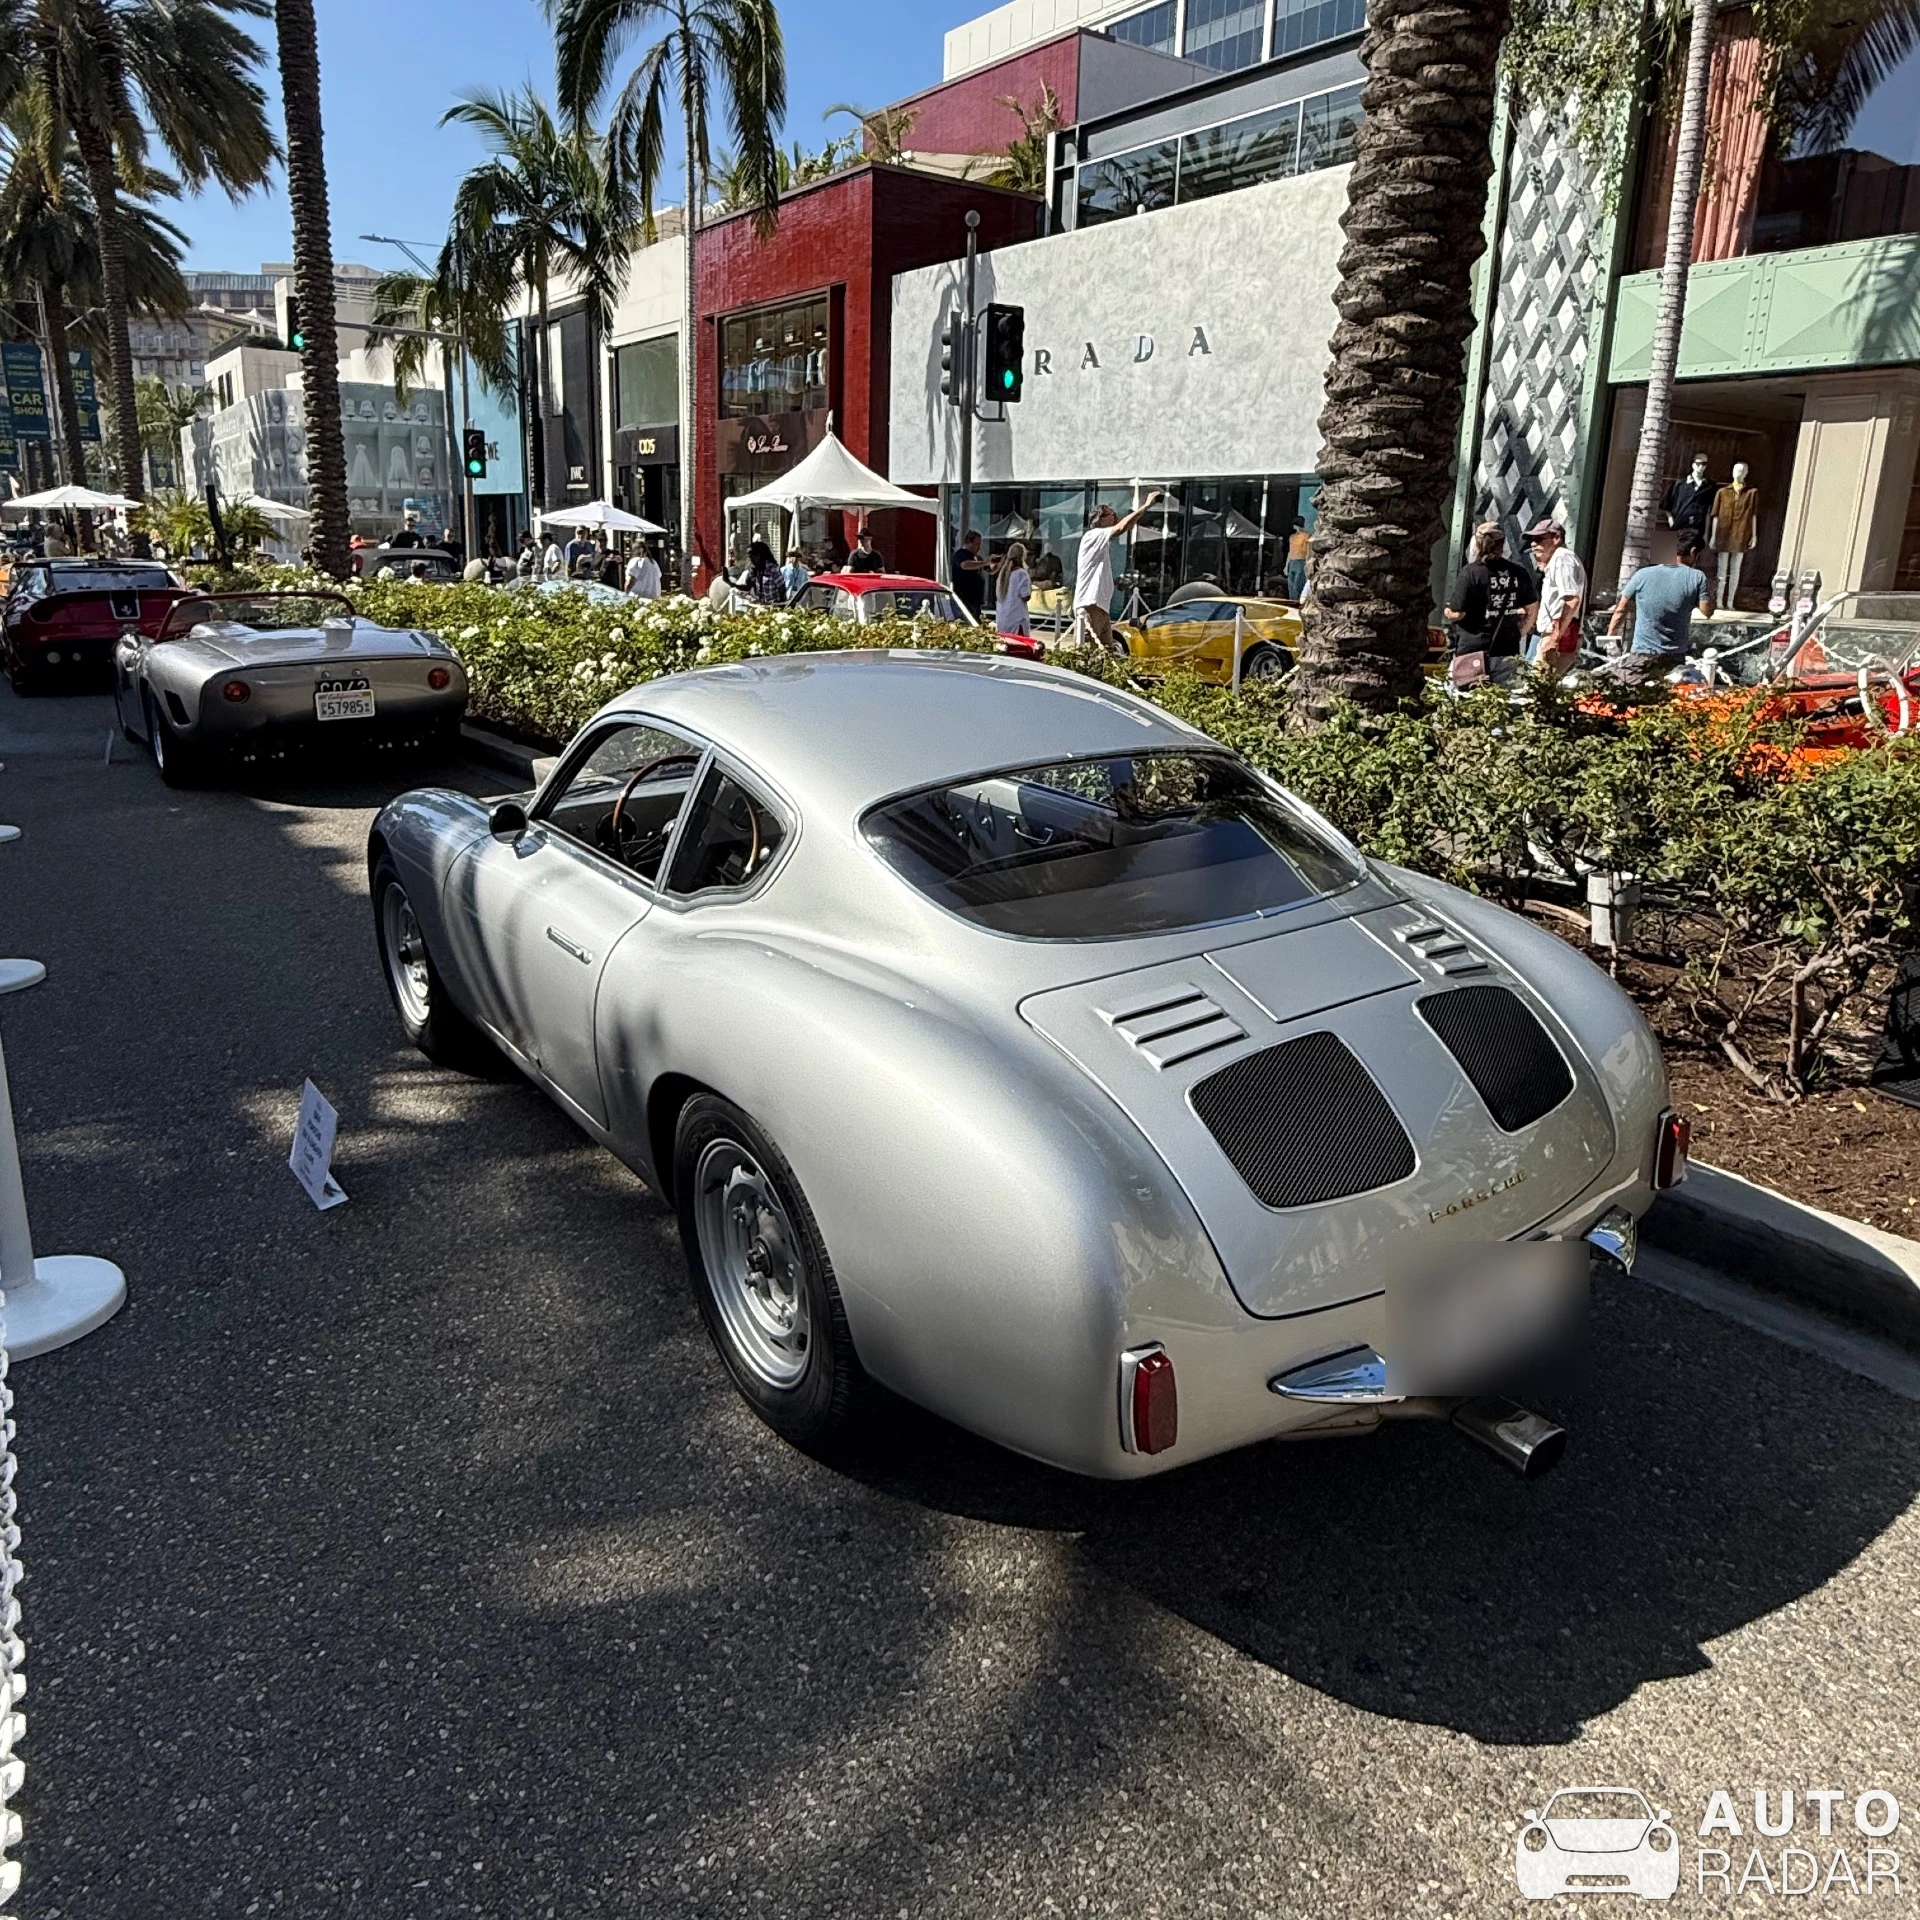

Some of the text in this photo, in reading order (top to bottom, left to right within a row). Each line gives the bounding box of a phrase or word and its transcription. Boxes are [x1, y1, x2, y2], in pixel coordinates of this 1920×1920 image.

[1034, 326, 1212, 376] RADA
[11, 393, 43, 405] CAR
[13, 407, 44, 415] SHOW
[328, 701, 364, 715] 57985
